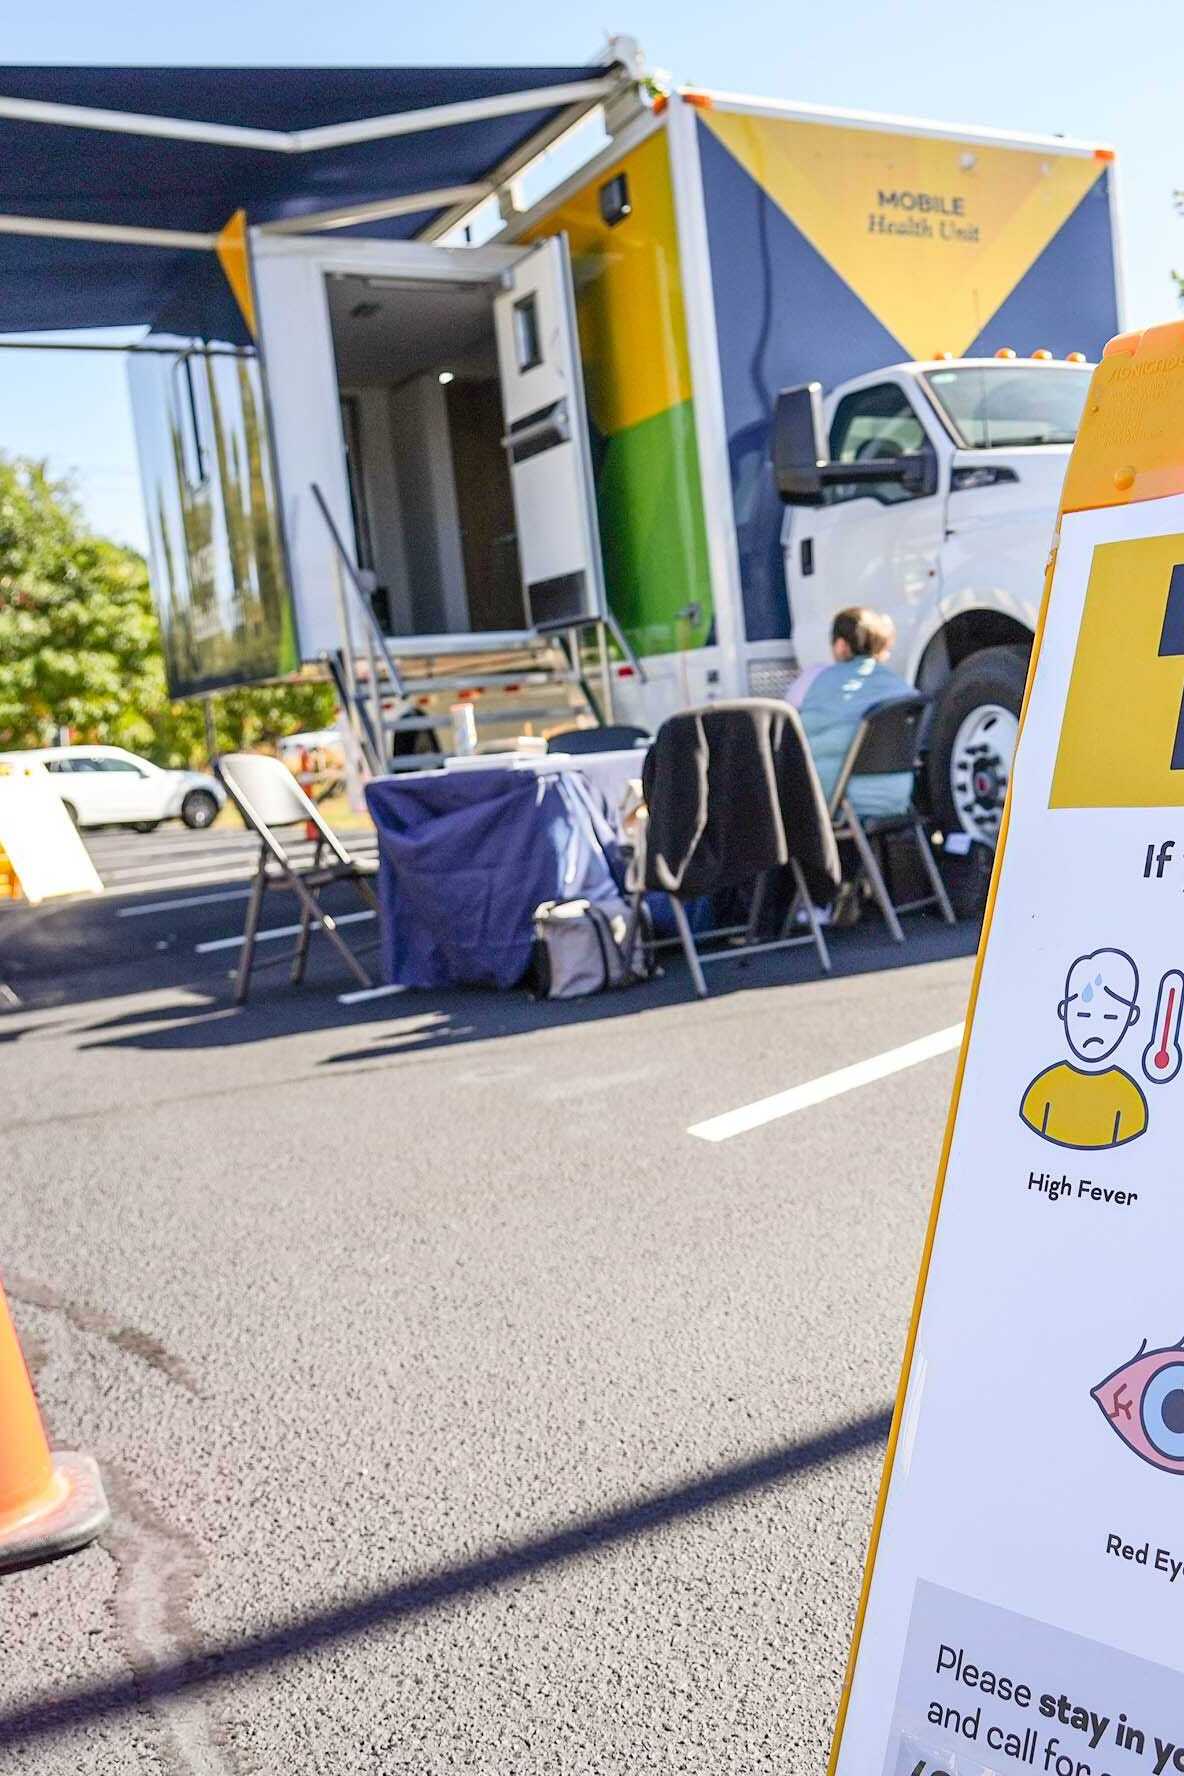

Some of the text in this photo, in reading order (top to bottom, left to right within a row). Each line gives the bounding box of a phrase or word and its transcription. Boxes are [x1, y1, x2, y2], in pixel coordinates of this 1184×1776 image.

[876, 188, 966, 217] MOBILE
[868, 212, 980, 243] Health Unit
[1143, 840, 1176, 879] If
[1027, 1171, 1138, 1206] High Fever
[1105, 1533, 1150, 1566] Red
[935, 1643, 1032, 1708] Please
[1038, 1694, 1111, 1750] stay
[1114, 1713, 1145, 1756] in
[927, 1701, 1091, 1776] and call for
